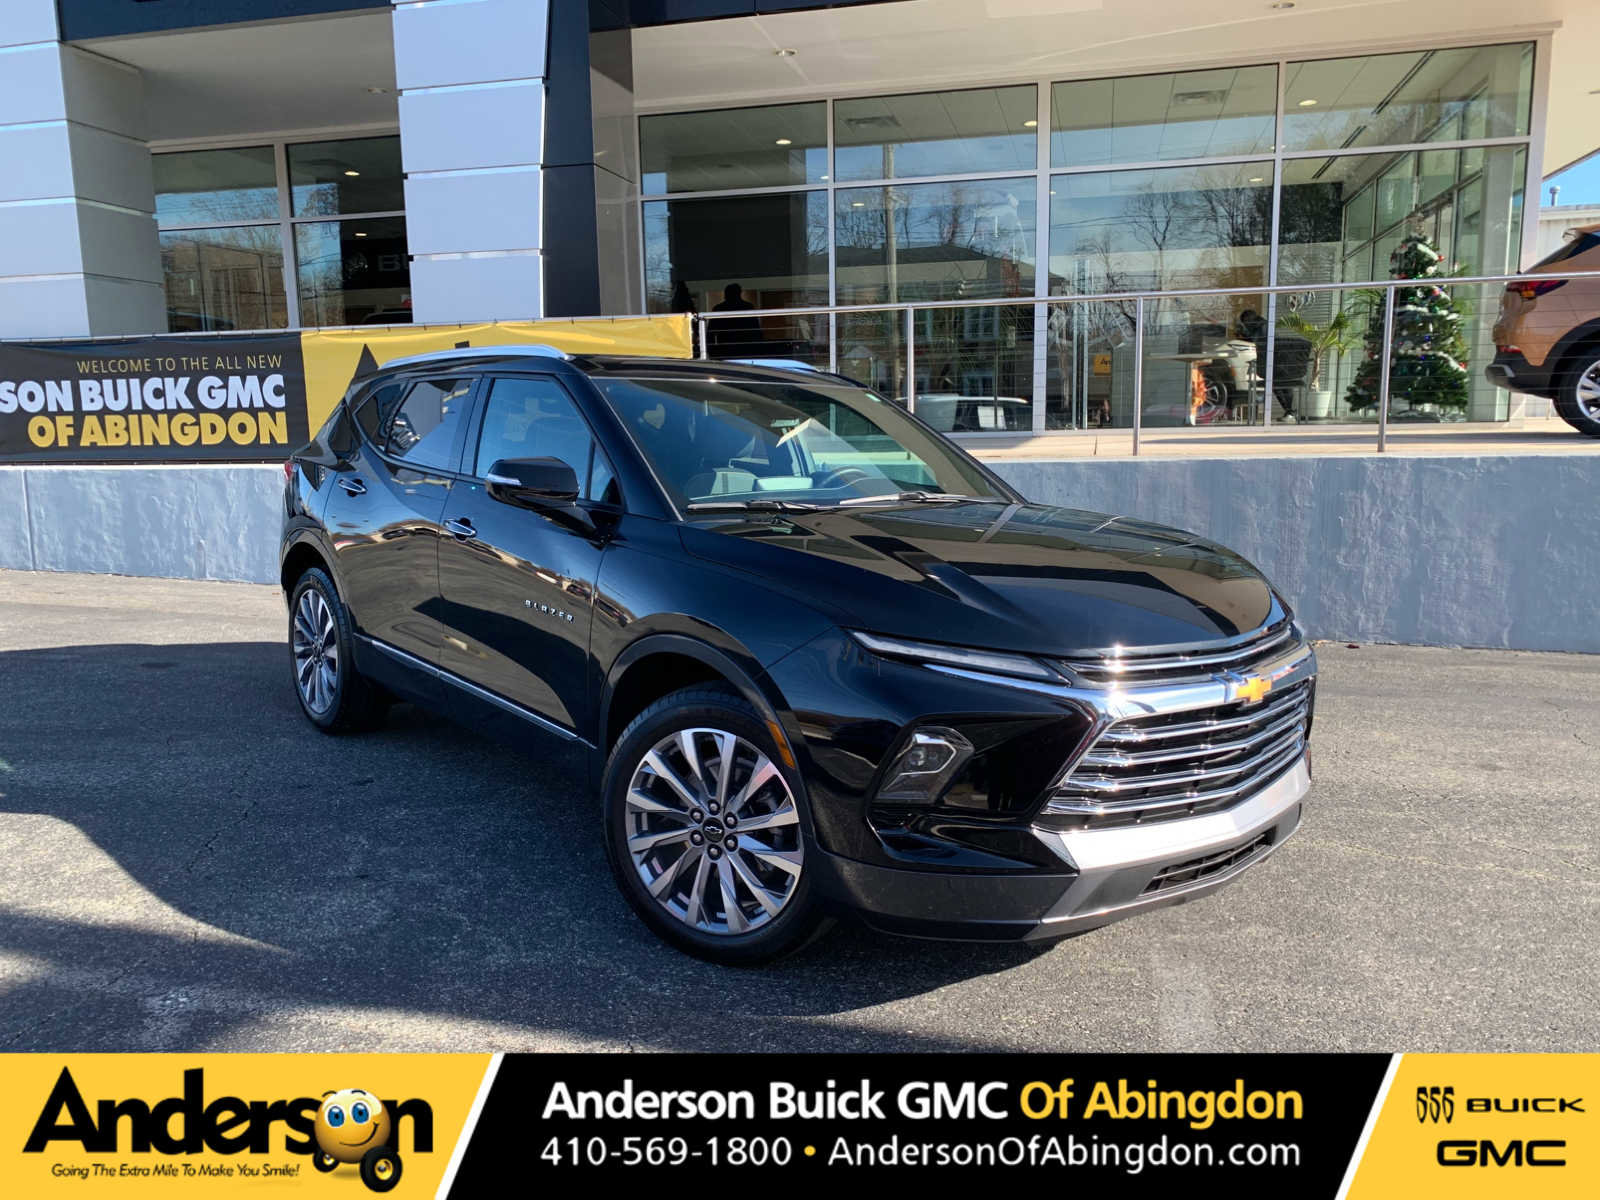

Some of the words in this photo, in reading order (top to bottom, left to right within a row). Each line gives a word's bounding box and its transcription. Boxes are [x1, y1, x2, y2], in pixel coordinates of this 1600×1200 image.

[77, 358, 152, 375] WELCOME
[156, 357, 177, 372] TO
[180, 356, 210, 372] THE
[215, 354, 243, 371] ALL
[246, 353, 283, 370] NEW
[0, 379, 73, 414] SON
[78, 376, 195, 412] BUICK
[197, 373, 287, 410] GMC
[27, 414, 75, 448] OF
[79, 411, 289, 447] ABINGDON
